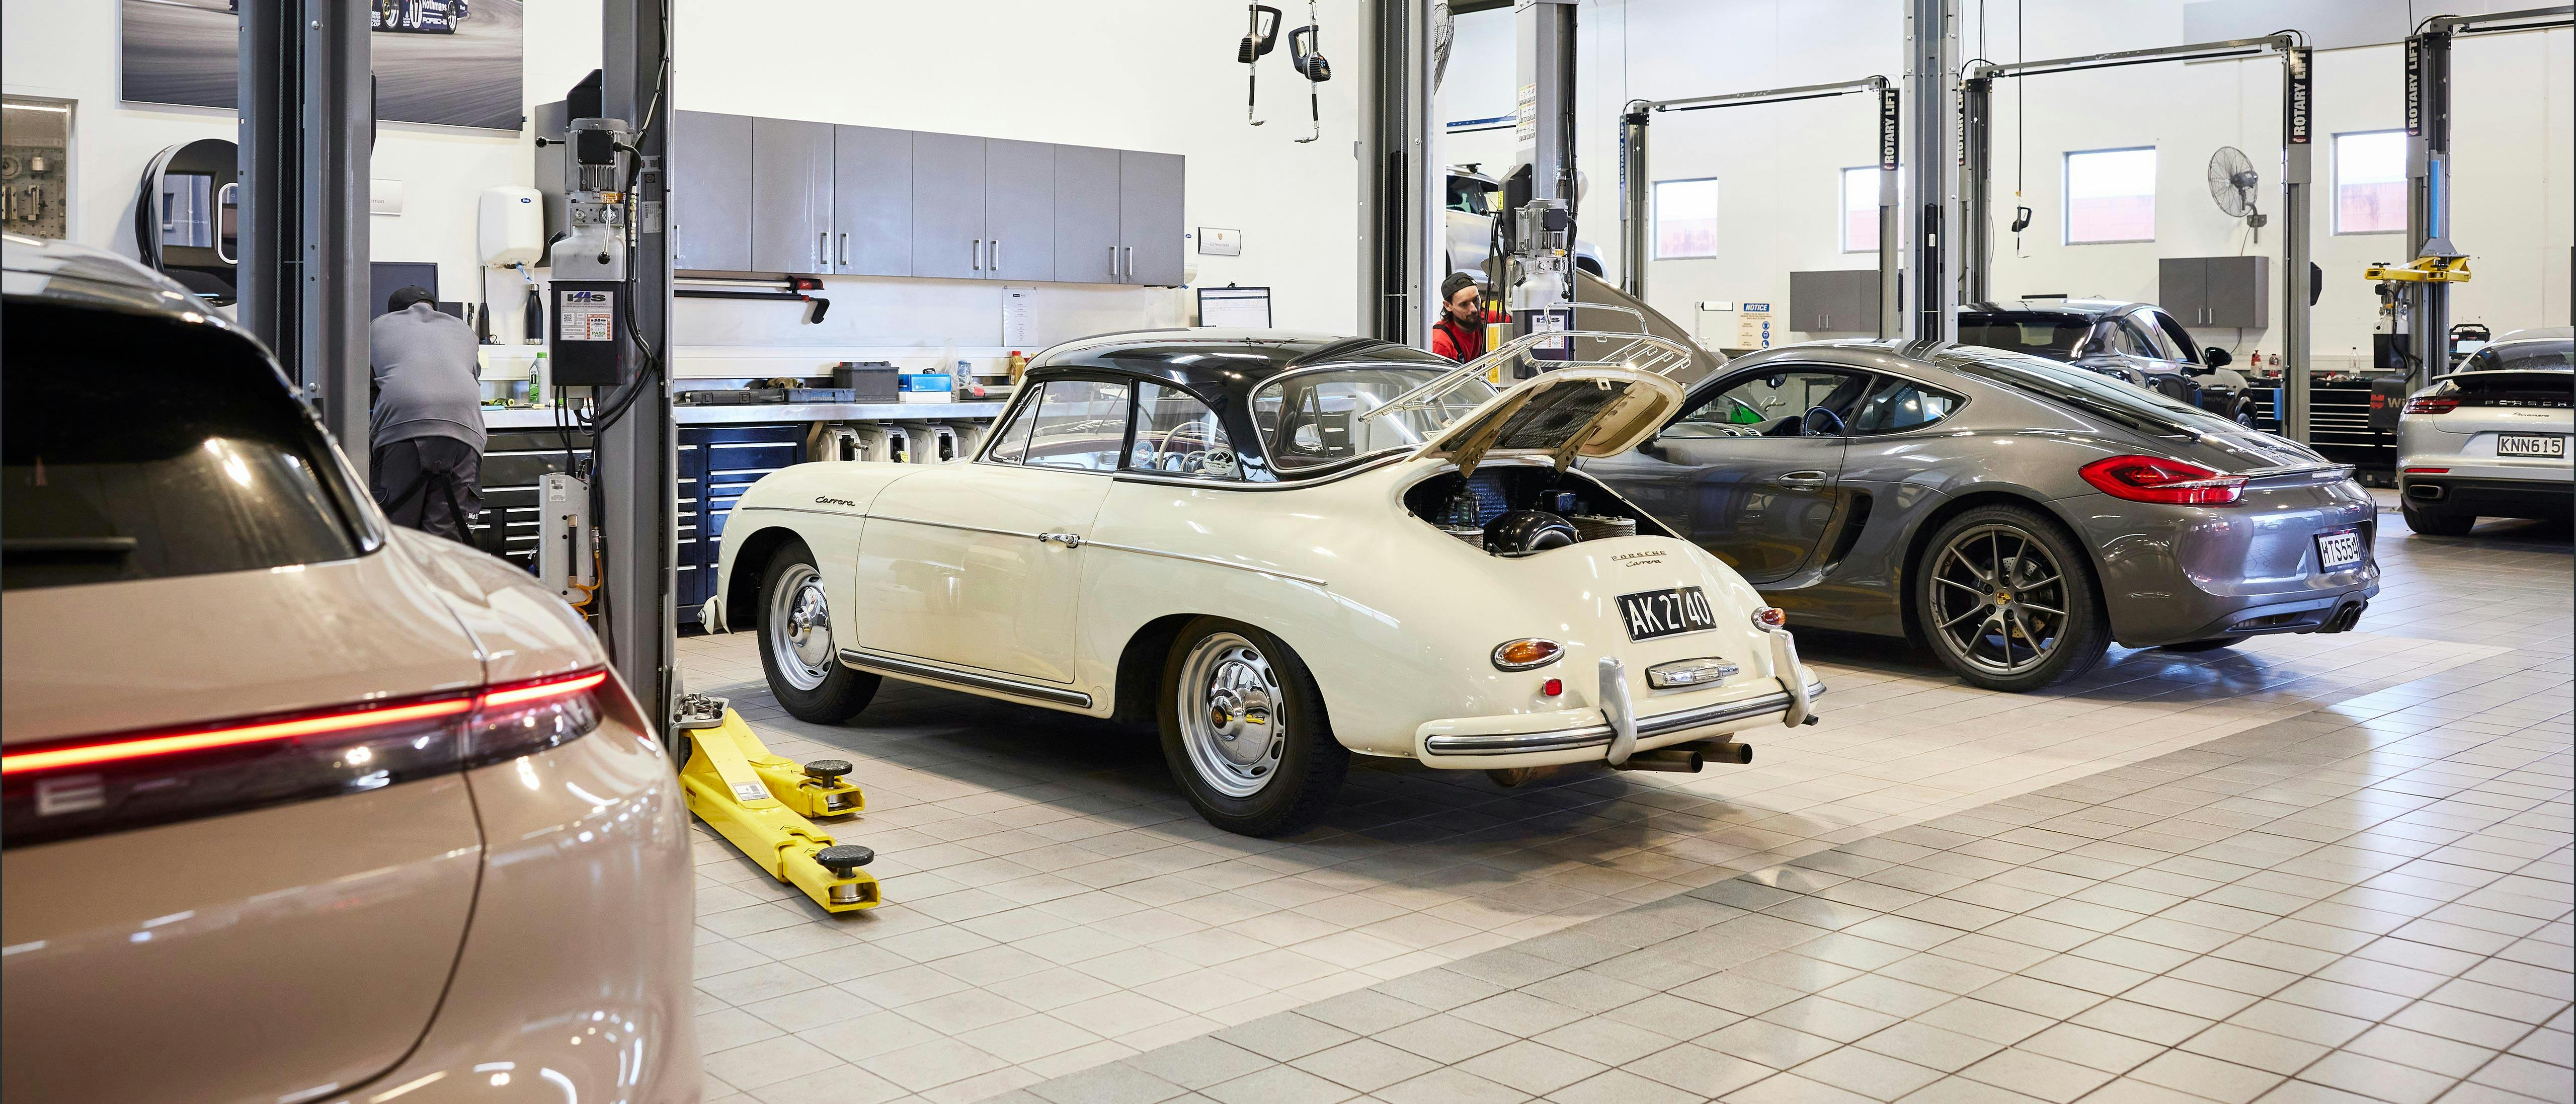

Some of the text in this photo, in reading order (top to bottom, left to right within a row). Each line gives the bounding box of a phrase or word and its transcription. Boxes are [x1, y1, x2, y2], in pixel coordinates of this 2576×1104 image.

[422, 0, 447, 12] Rothmans
[422, 17, 447, 25] PORSCHE
[2409, 41, 2418, 128] ROTARY LIFT
[2294, 51, 2306, 135] ROTARY LIFT
[1885, 91, 1895, 115] LIFT
[1885, 118, 1895, 164] ROTARY
[2501, 438, 2561, 453] KNN615
[815, 495, 856, 506] Carrera
[1612, 550, 1667, 561] PORSCHE
[2321, 537, 2359, 564] HTS554
[1626, 559, 1662, 567] Carrera
